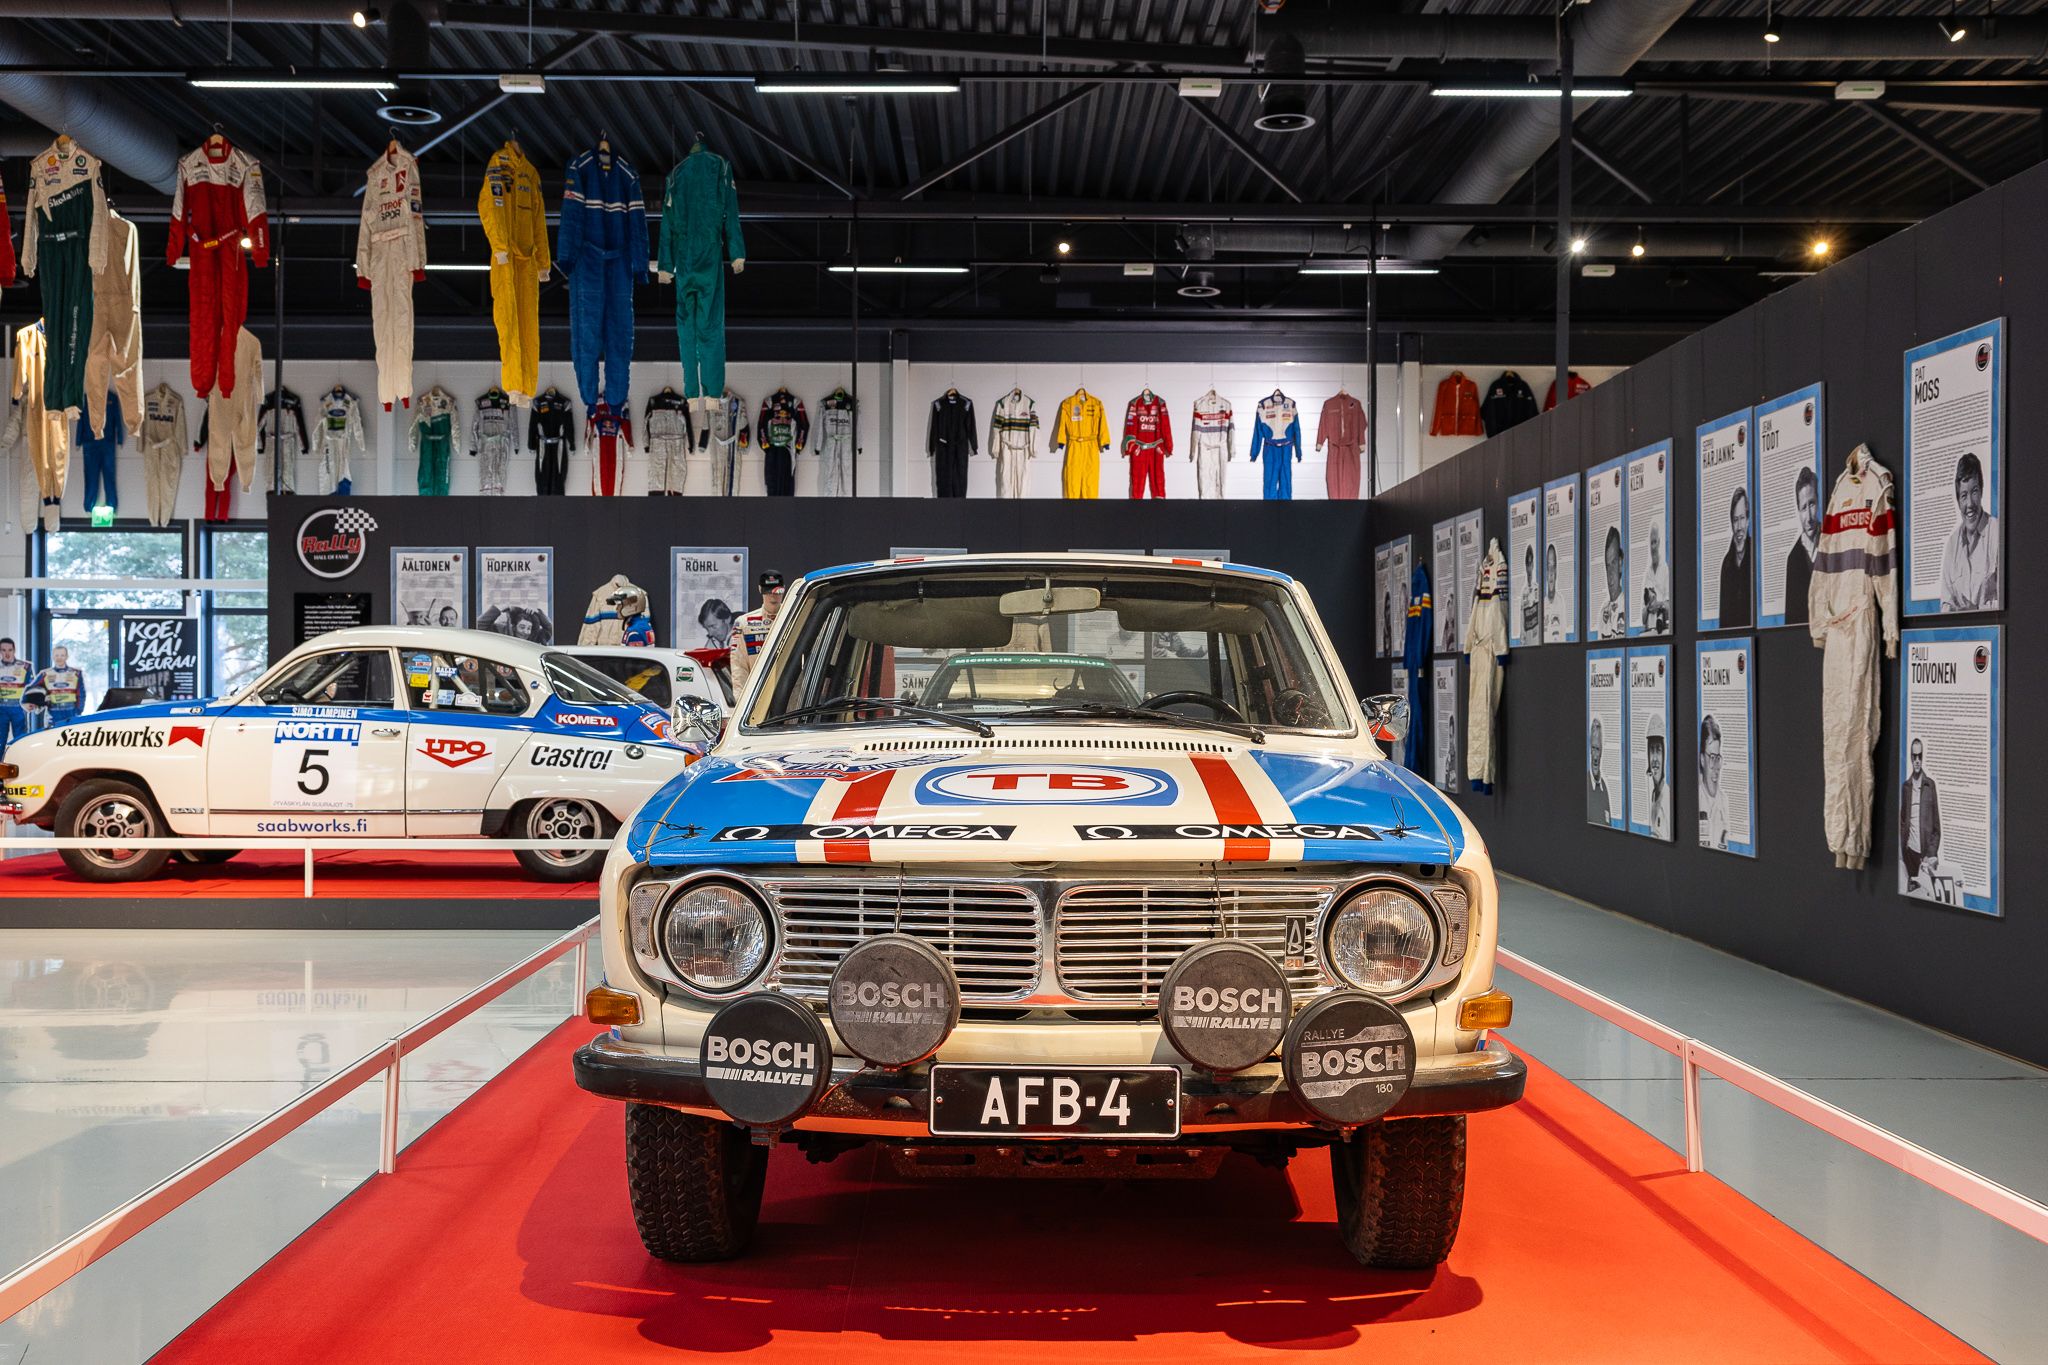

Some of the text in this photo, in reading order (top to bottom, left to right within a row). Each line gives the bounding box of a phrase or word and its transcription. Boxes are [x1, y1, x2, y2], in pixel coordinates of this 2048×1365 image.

[1914, 366, 1926, 382] PAT
[1914, 377, 1940, 405] MOSS
[1761, 429, 1779, 452] TODT
[302, 533, 362, 554] Rally
[401, 560, 451, 572] AALTONEN
[487, 560, 531, 572] HOPKIRK
[127, 620, 183, 642] KOE!
[128, 637, 182, 666] JAA!
[135, 654, 197, 672] SEURAA!
[1049, 657, 1105, 667] MICHELIN
[1702, 668, 1731, 686] SALONEN
[1911, 662, 1957, 684] TOIVONEN
[291, 707, 358, 719] SIMO LAMPINEN
[557, 714, 615, 726] KOMETA
[56, 727, 164, 748] Saabworks
[276, 722, 360, 740] NORTTI
[425, 738, 486, 756] UPO
[530, 745, 613, 770] Castrol
[297, 749, 330, 796] 5
[967, 773, 1130, 791] TB
[257, 818, 367, 832] saabworks.fi
[809, 825, 1003, 840] OMEGA
[1175, 824, 1376, 840] OMEGA
[837, 981, 945, 1009] BOSCH
[1173, 985, 1284, 1014] BOSCH
[1209, 1016, 1271, 1030] RALLYE
[1303, 1028, 1345, 1041] RALLYE
[707, 1035, 816, 1070] BOSCH
[1301, 1044, 1407, 1078] BOSCH
[742, 1069, 803, 1086] RALLYE
[1375, 1083, 1394, 1094] 180
